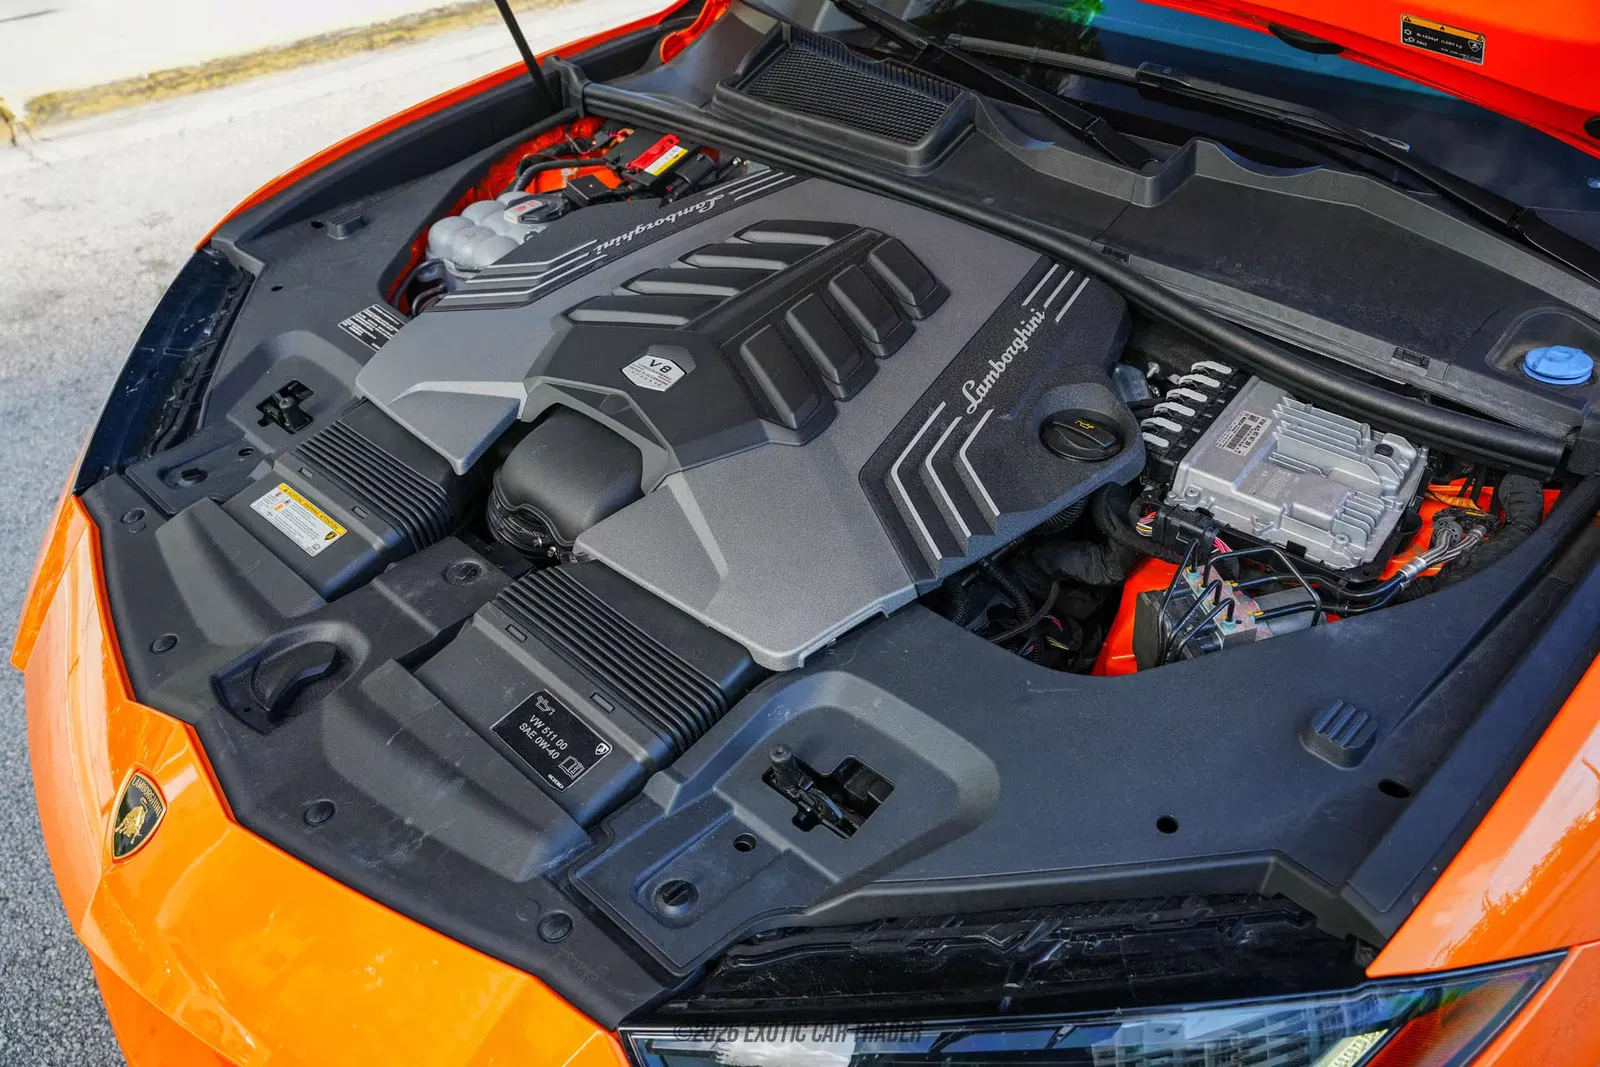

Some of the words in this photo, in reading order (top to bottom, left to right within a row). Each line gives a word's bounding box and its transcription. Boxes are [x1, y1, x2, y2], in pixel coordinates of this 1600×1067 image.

[593, 194, 725, 255] Lamborghini
[650, 359, 672, 373] V8
[962, 308, 1045, 415] Lamborghini
[518, 722, 538, 739] SAE
[534, 736, 560, 760] 0W-40
[529, 714, 546, 729] VW
[541, 726, 558, 741] 511
[555, 738, 569, 750] 00
[131, 776, 163, 818] LAMBORGHINI
